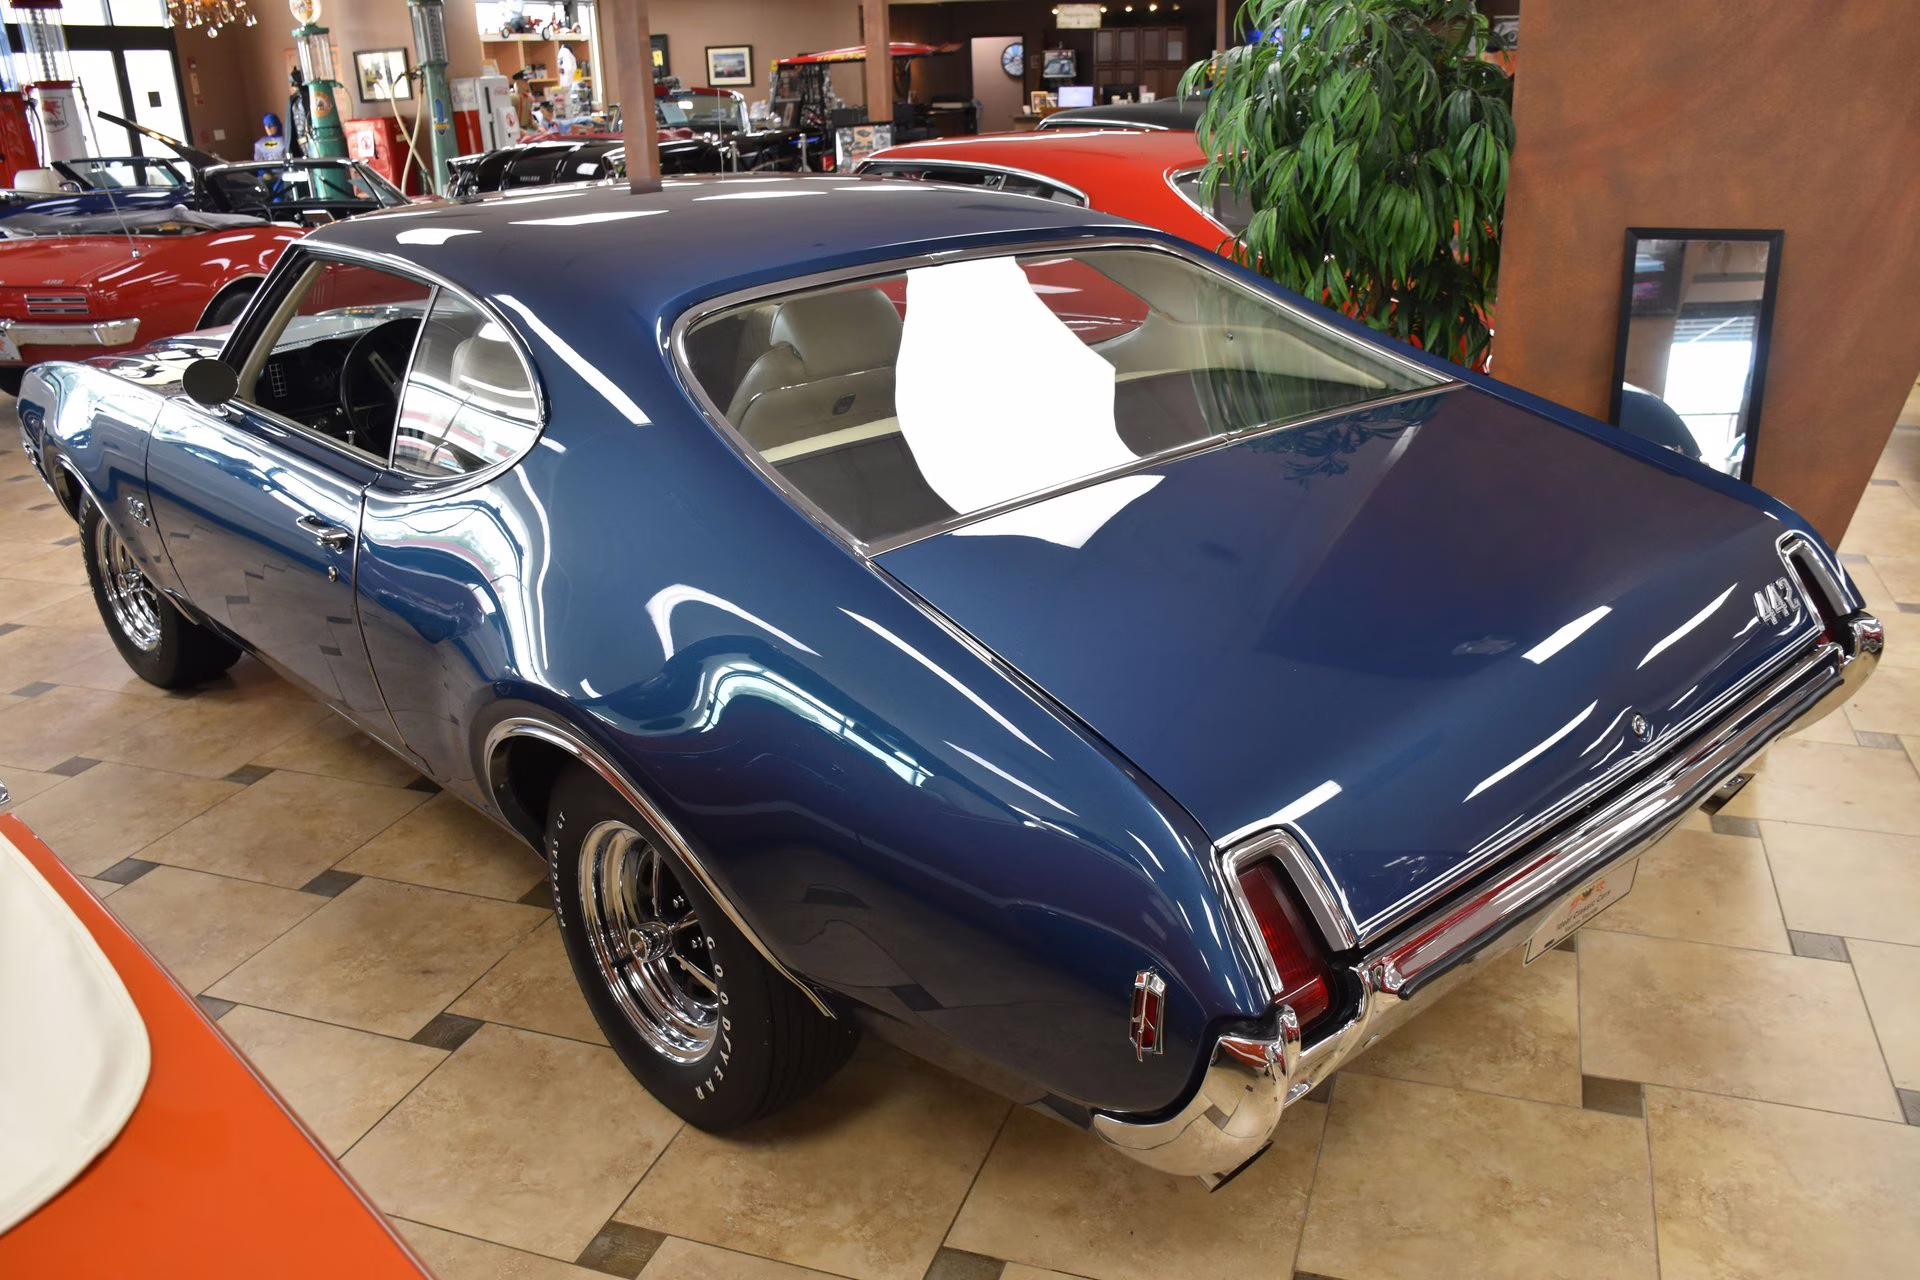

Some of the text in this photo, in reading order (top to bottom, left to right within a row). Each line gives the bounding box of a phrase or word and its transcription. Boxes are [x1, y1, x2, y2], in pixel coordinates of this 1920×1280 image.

[1753, 577, 1801, 625] 442
[553, 811, 567, 928] POLYGLAS GT
[695, 935, 731, 1100] GOODYEAR
